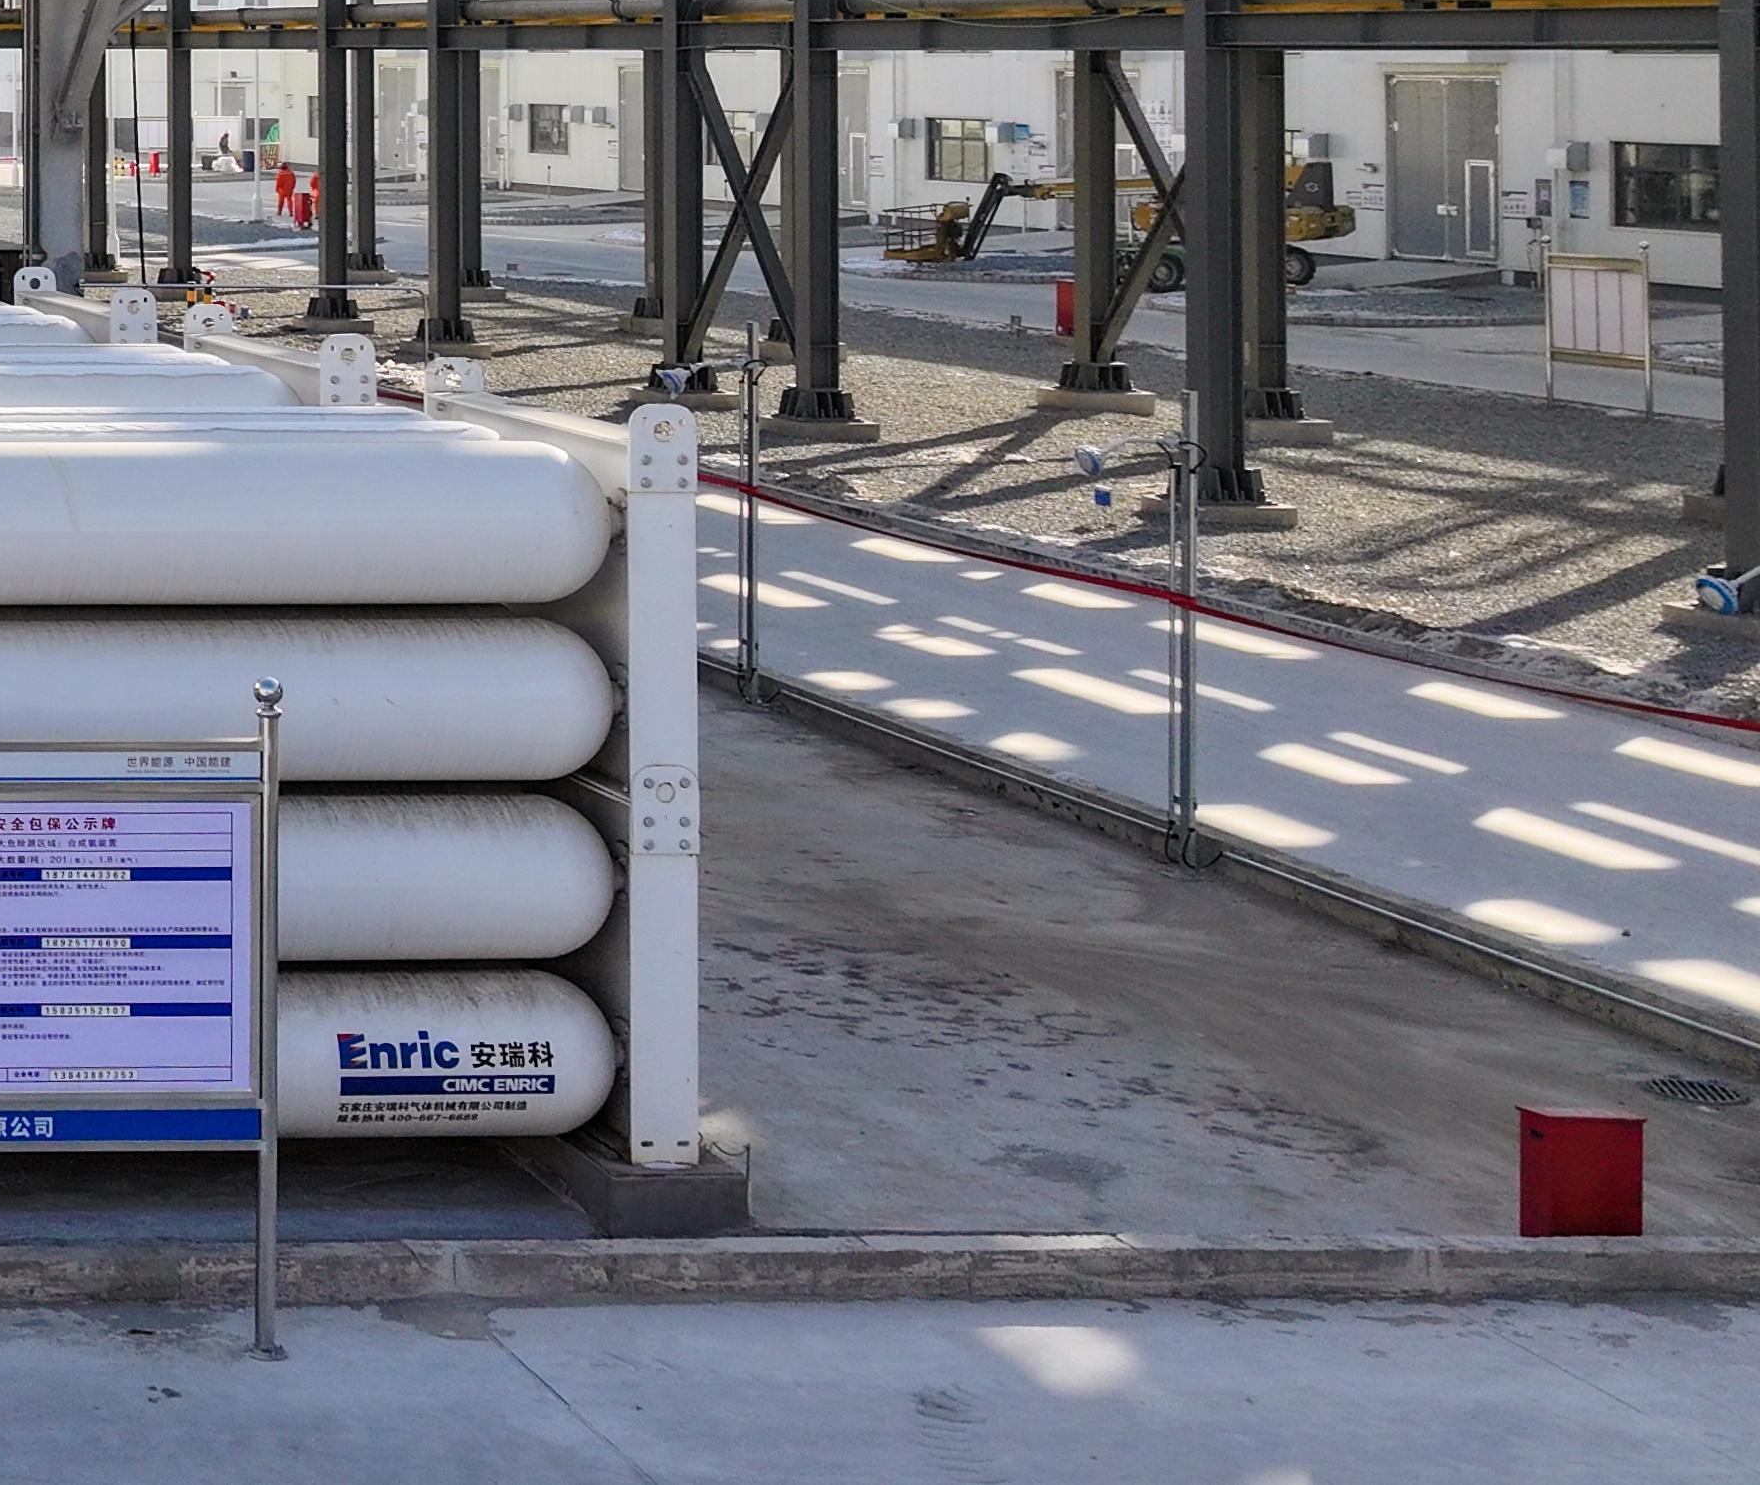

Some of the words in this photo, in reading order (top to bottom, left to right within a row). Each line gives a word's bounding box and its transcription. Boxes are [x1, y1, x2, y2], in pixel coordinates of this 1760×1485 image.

[127, 756, 174, 768] 世界能源
[184, 756, 231, 768] 中国能建
[336, 1030, 460, 1070] Enric
[470, 1040, 554, 1068] 安瑞科
[442, 1078, 491, 1093] CIMC
[493, 1077, 549, 1092] ENRIC
